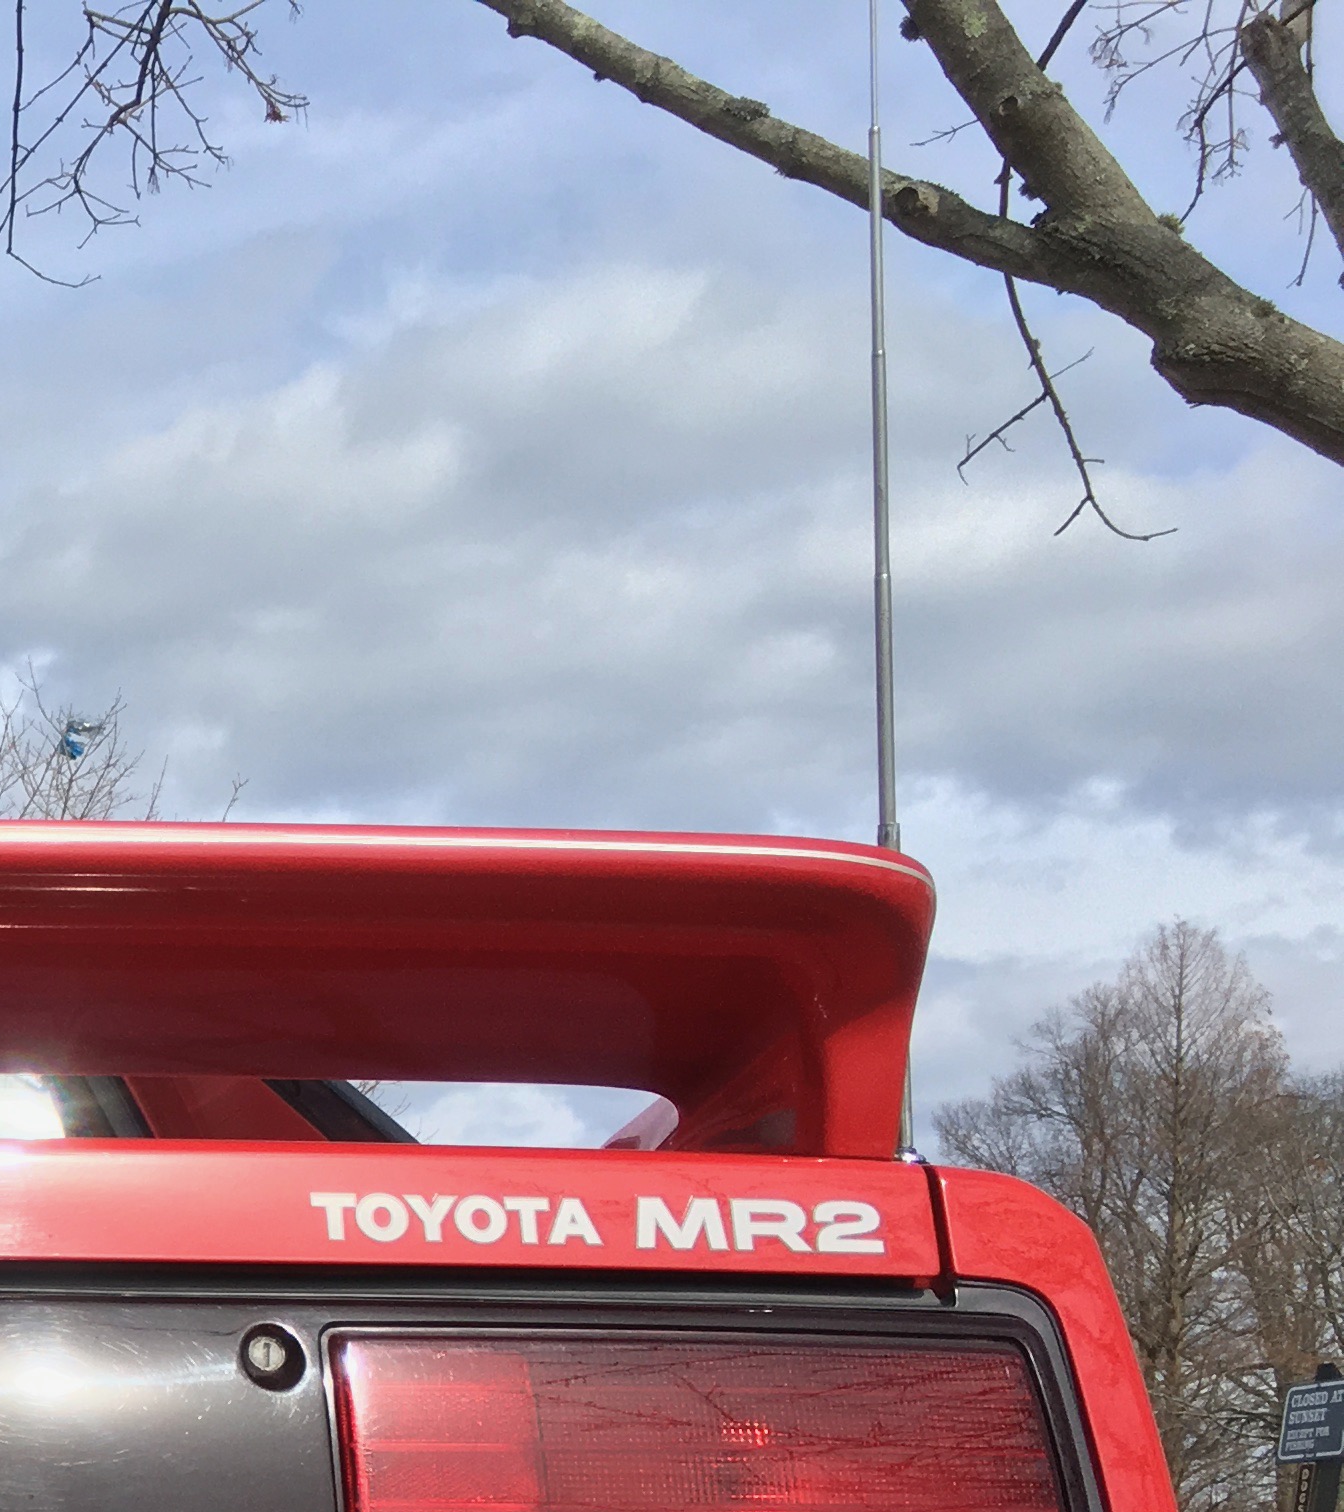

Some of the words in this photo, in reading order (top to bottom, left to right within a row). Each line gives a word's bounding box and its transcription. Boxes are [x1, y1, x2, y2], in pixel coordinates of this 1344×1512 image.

[310, 1191, 606, 1247] TOYOTA
[635, 1194, 887, 1256] MR2
[1291, 1391, 1329, 1408] CLOSED
[1288, 1407, 1329, 1425] SUNSET
